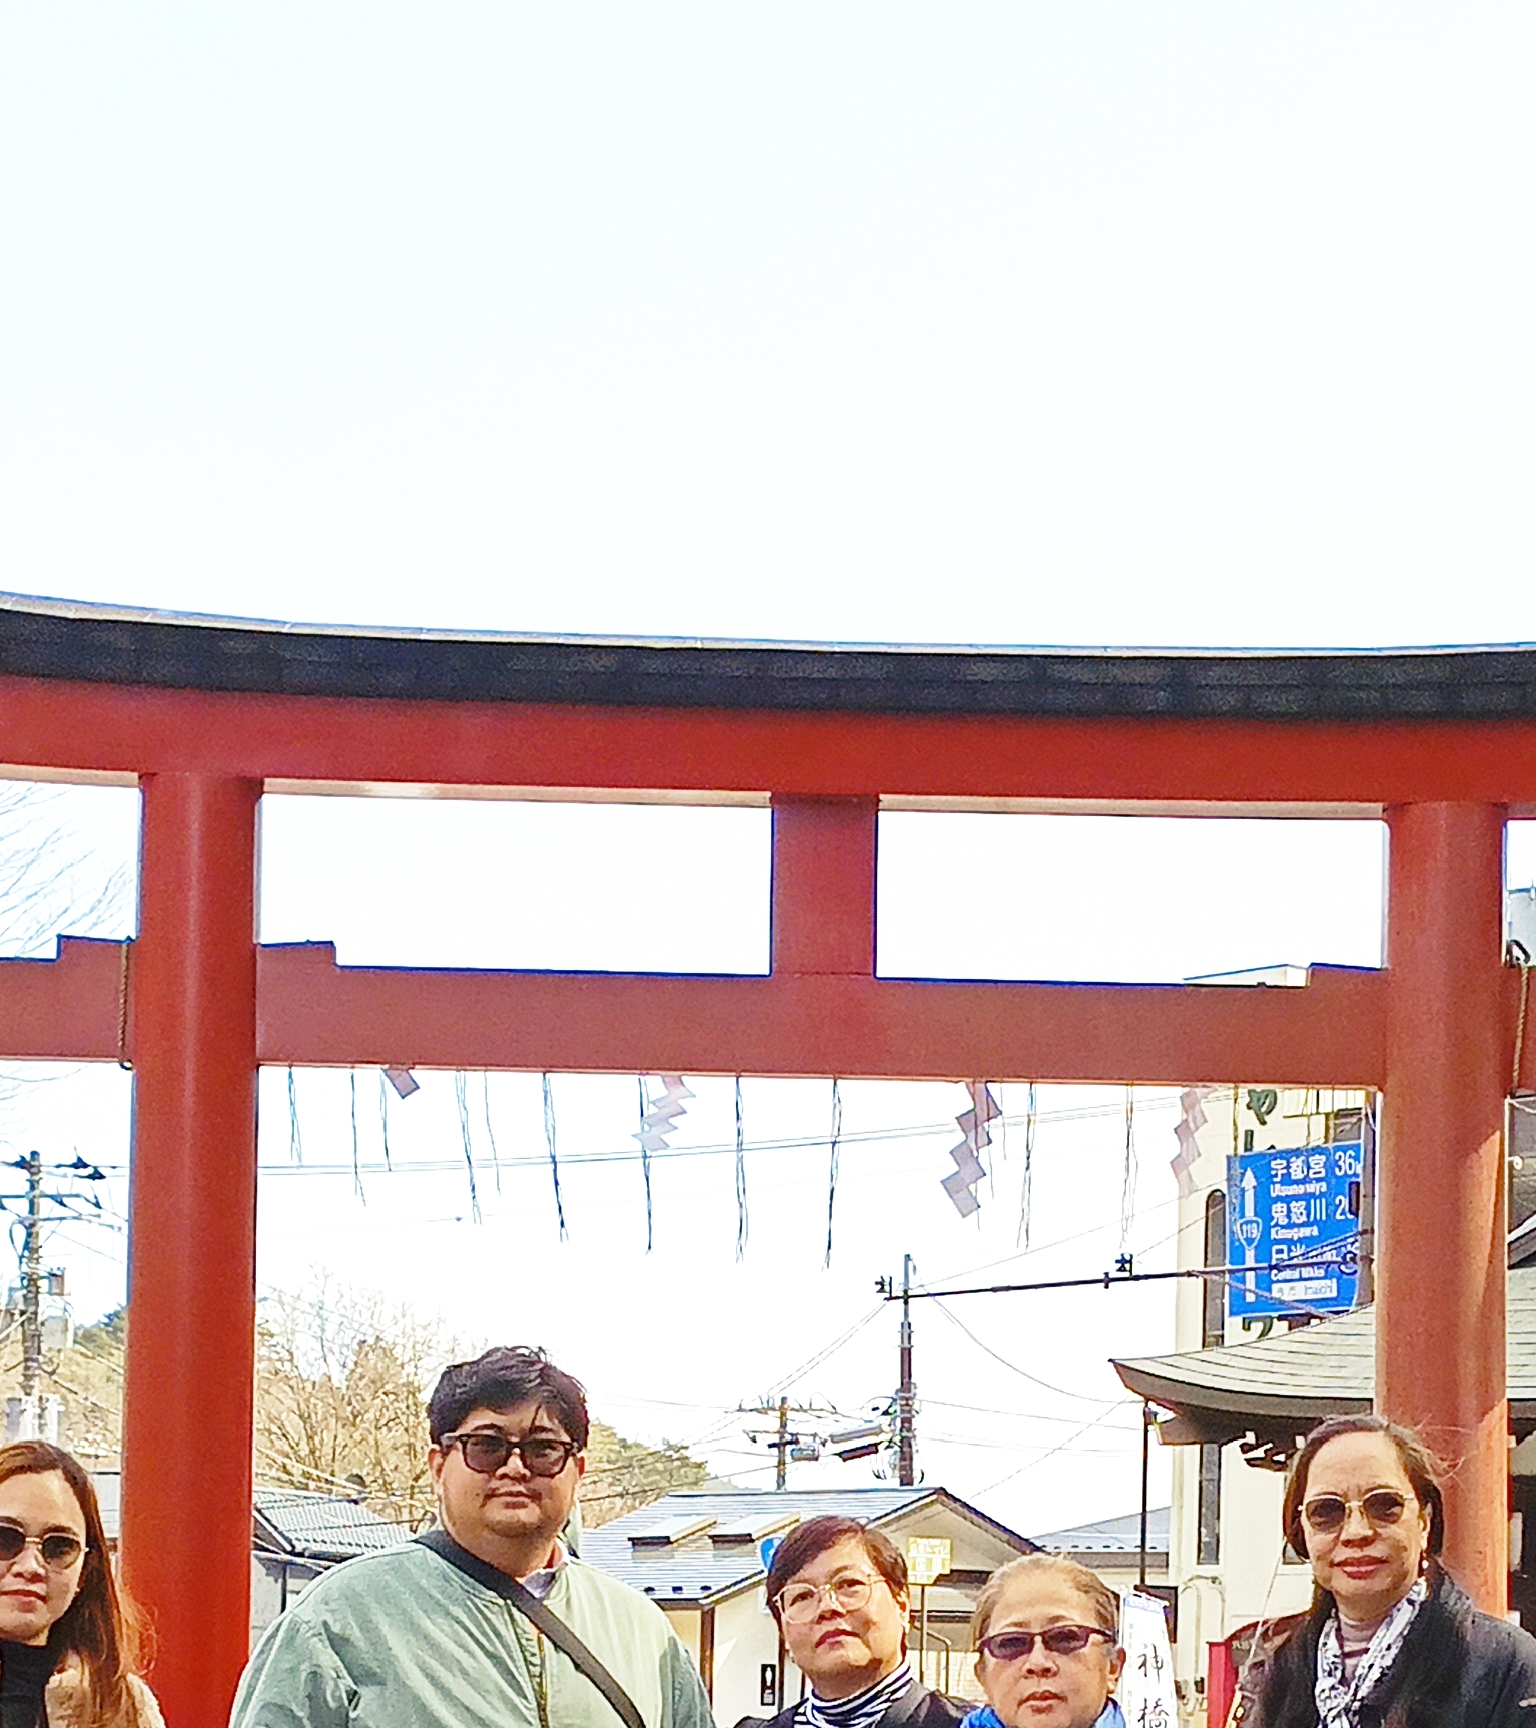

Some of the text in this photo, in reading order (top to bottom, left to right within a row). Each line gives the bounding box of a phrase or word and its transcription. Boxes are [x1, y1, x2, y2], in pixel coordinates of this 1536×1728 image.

[1270, 1154, 1327, 1182] 宇都宮
[1270, 1198, 1327, 1226] 鬼怒川
[1241, 1222, 1258, 1240] 119
